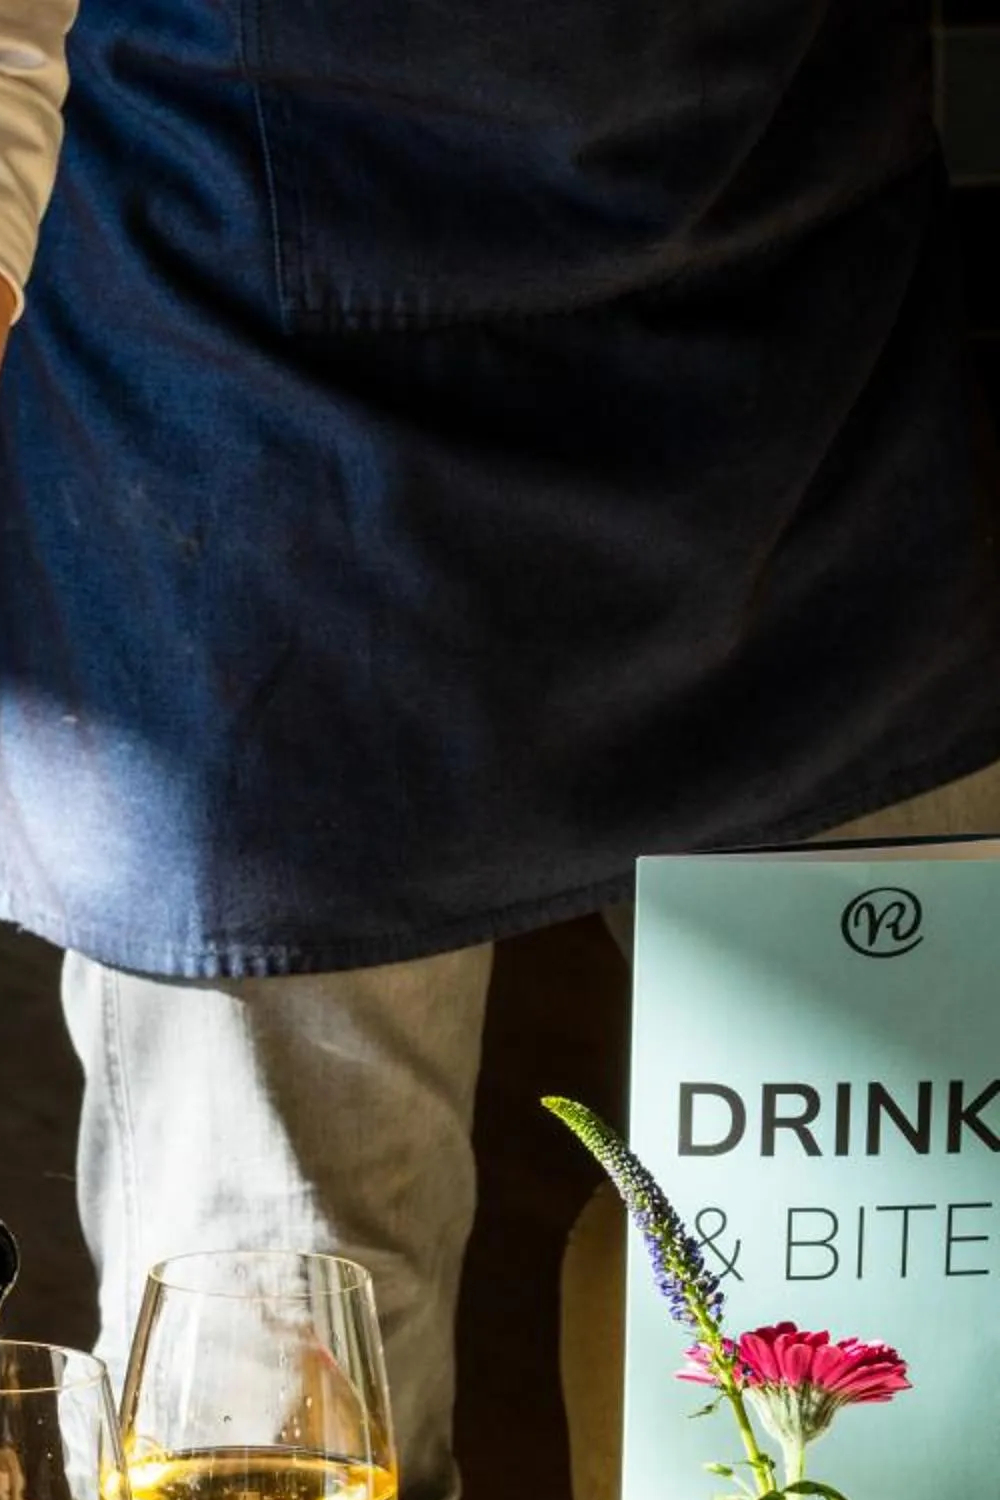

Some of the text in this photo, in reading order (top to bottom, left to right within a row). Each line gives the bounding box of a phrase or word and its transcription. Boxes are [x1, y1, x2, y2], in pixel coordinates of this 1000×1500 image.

[677, 1079, 1000, 1157] DRINK
[694, 1202, 993, 1281] & BITE
